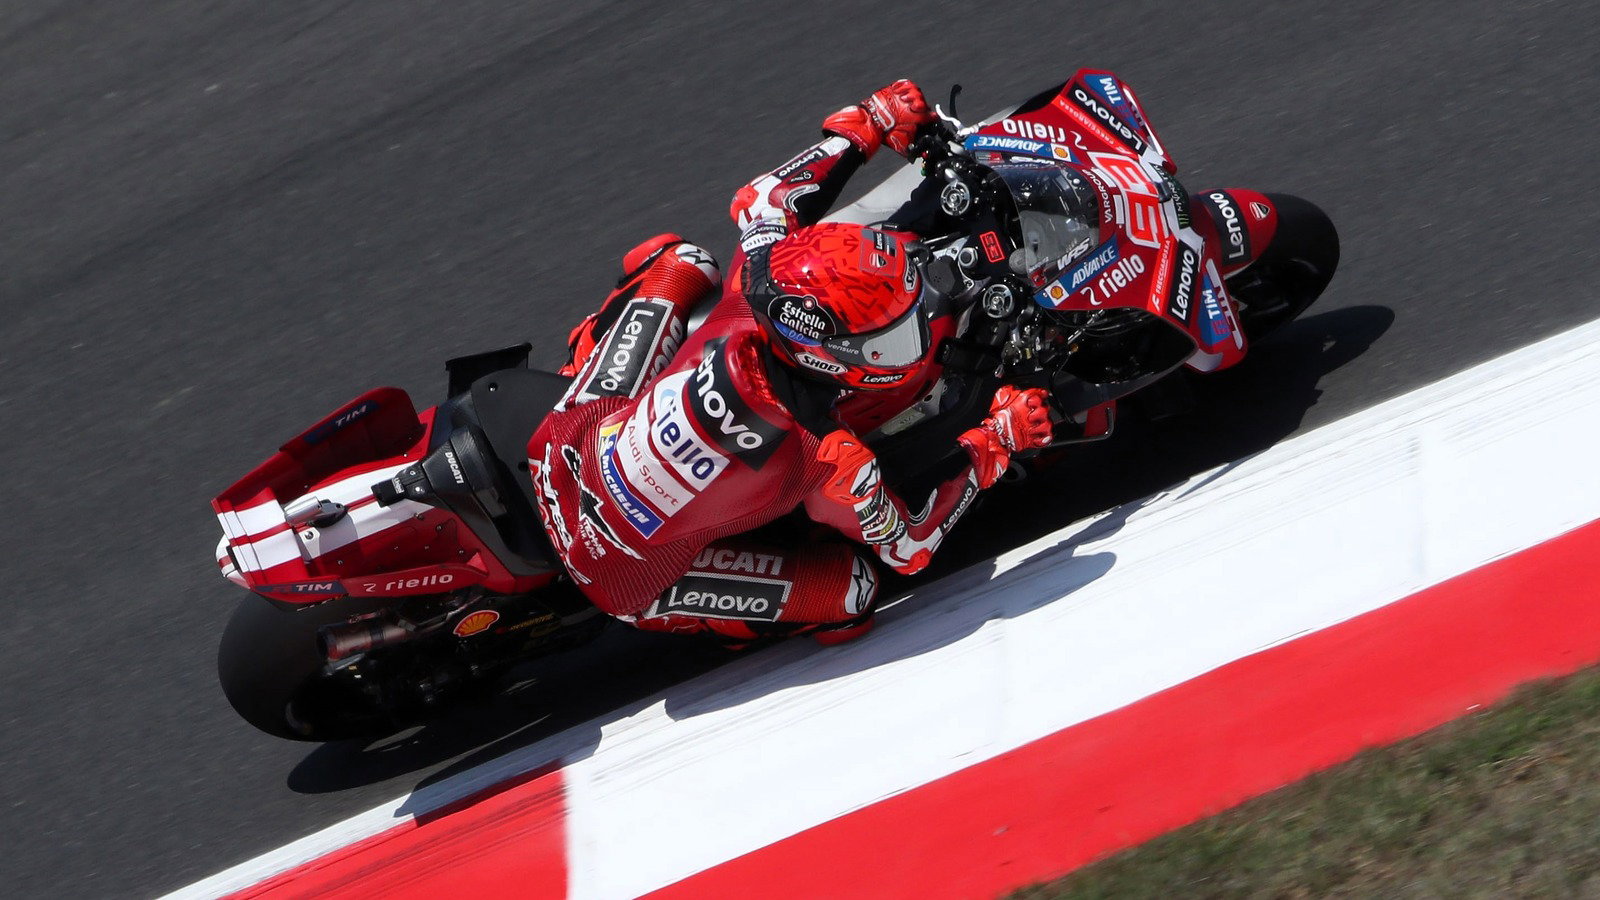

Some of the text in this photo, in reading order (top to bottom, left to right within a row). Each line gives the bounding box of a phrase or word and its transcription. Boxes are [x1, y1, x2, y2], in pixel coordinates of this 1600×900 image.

[1099, 77, 1122, 104] TIM
[1002, 118, 1066, 144] riello
[1074, 88, 1143, 151] Lenovo
[977, 136, 1045, 154] ADVANCE
[778, 150, 824, 177] Lenovo
[1081, 168, 1111, 225] VARGROUP
[1210, 192, 1244, 260] Lenovo
[1057, 237, 1091, 271] WRS
[1071, 245, 1117, 289] ADVANCE
[1155, 239, 1172, 296] FRECCIAROSSA
[1099, 254, 1146, 299] riello
[1172, 249, 1195, 321] Lenovo
[781, 301, 827, 331] Estrella
[1202, 288, 1221, 319] TIM
[779, 313, 820, 340] Galicia
[600, 309, 654, 391] Lenovo
[802, 355, 841, 373] SHOEI
[863, 374, 903, 384] Lenovo
[335, 404, 367, 428] TIM
[696, 350, 764, 450] enovo
[657, 398, 716, 481] iello
[445, 451, 464, 484] DUCATI
[627, 425, 680, 507] Audi Sport
[600, 455, 651, 525] MICHELIN
[943, 488, 974, 529] Lenovo
[693, 547, 784, 576] UCATI
[296, 582, 333, 592] TIM
[385, 573, 454, 591] riello
[668, 586, 770, 613] Lenovo
